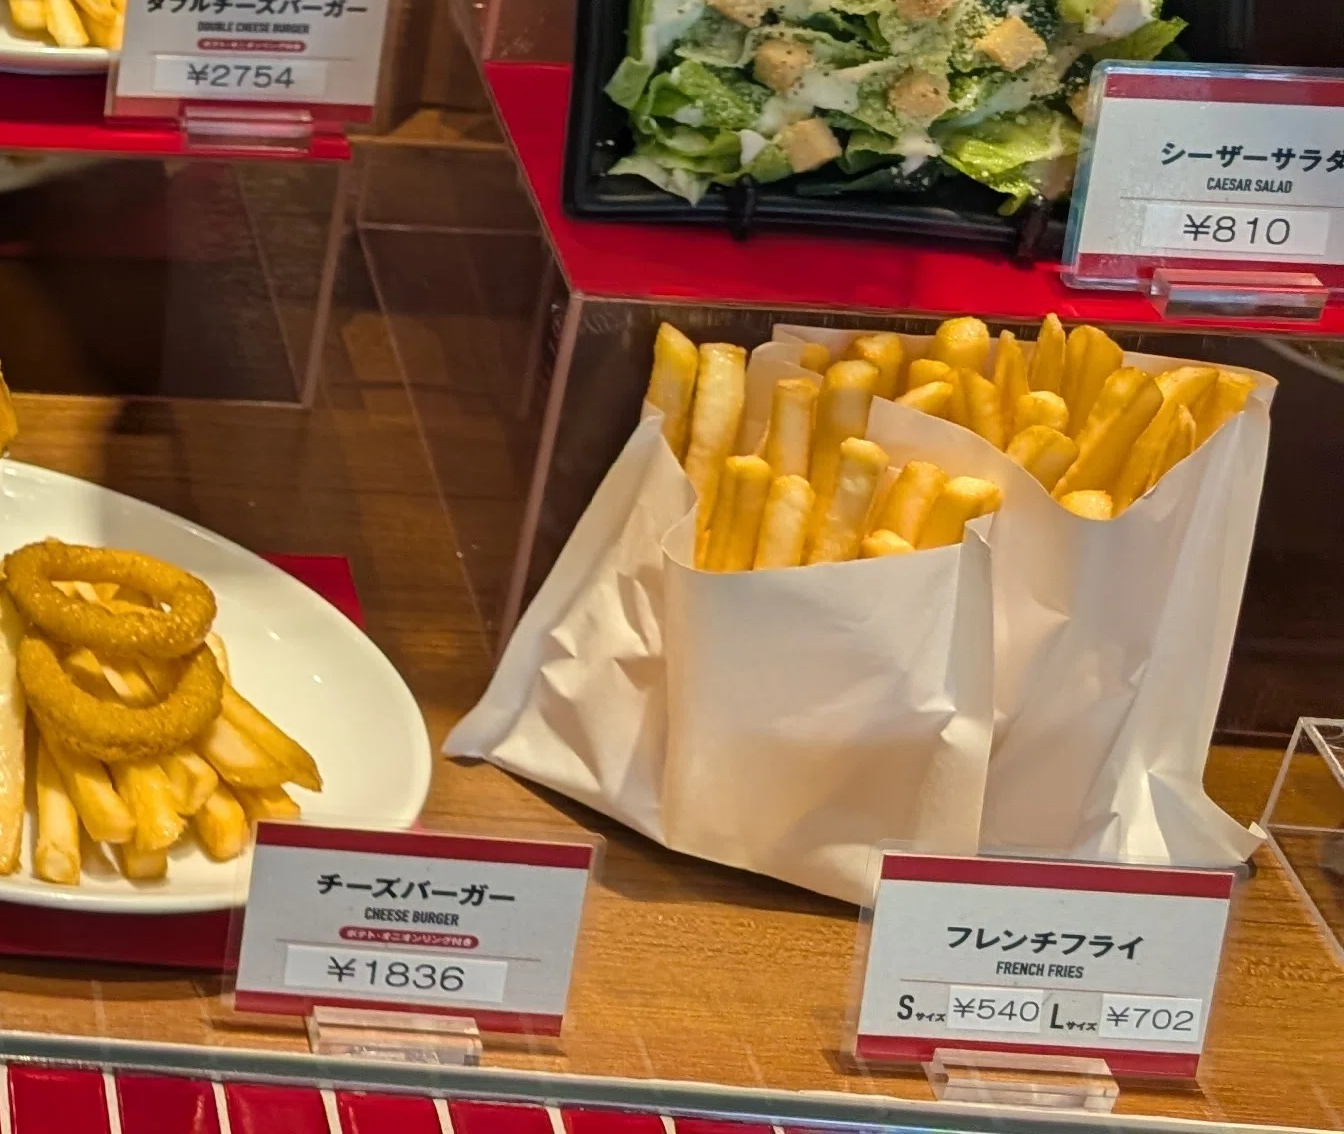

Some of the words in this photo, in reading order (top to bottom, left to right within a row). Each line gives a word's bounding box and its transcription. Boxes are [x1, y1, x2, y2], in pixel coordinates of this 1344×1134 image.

[186, 62, 295, 89] ¥2754
[1206, 176, 1252, 192] CAESAR
[1253, 178, 1293, 194] SALAD
[1182, 213, 1291, 246] ¥810
[316, 873, 516, 907] チーズバーガー
[364, 907, 410, 924] CHEESE
[411, 909, 460, 927] BURGER
[946, 925, 1145, 960] フレンチフライ
[326, 955, 466, 992] ¥1836
[996, 960, 1046, 977] FRENCH
[1047, 963, 1085, 980] FRIES
[952, 996, 1041, 1023] ¥540
[1105, 1005, 1196, 1032] ¥702
